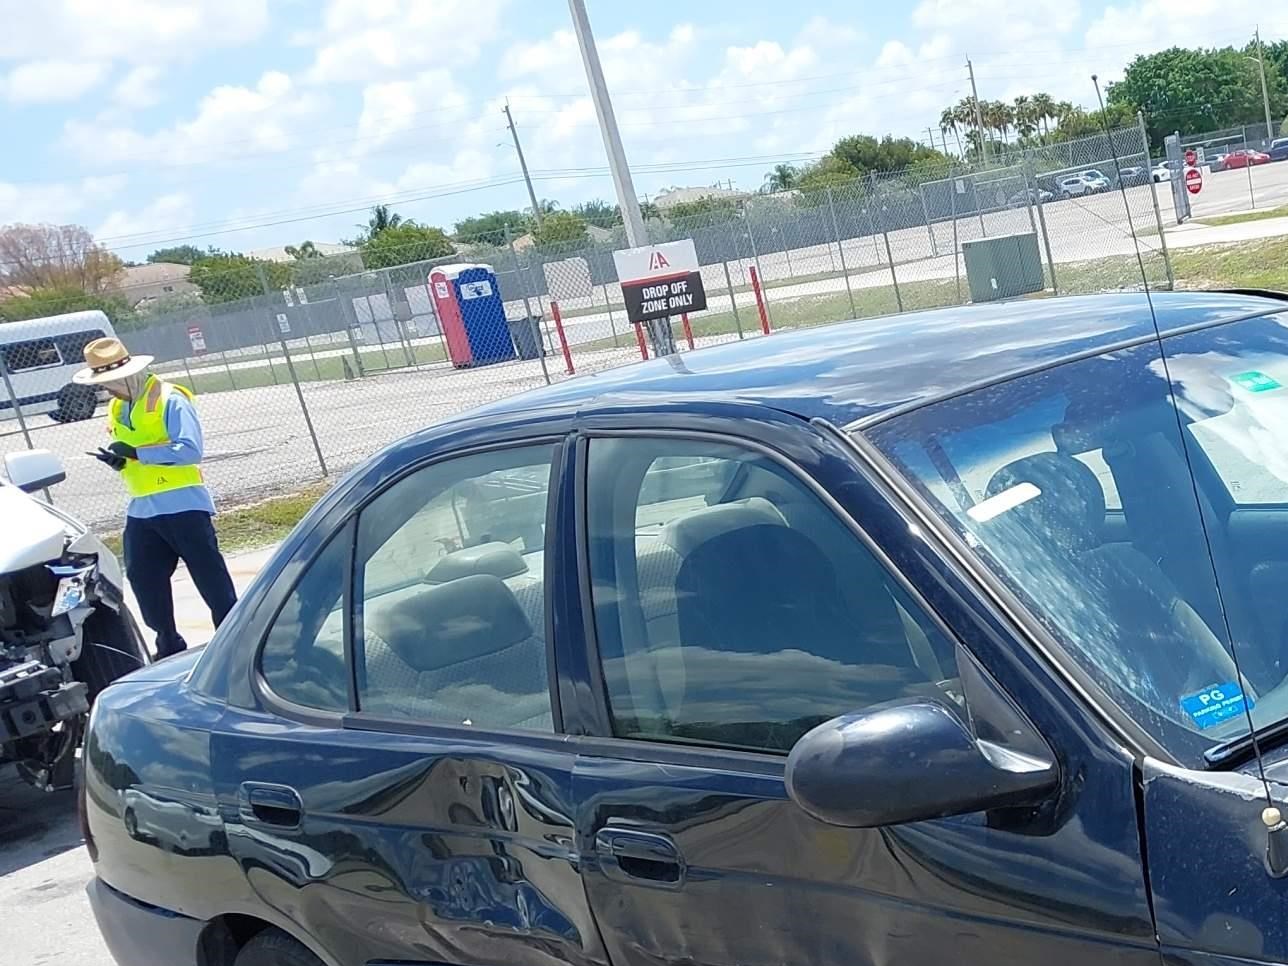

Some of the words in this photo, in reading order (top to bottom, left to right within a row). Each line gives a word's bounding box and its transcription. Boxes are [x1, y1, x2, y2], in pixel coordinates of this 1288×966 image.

[642, 285, 668, 300] DROP
[670, 281, 688, 294] OFF
[641, 297, 668, 314] ZONE
[669, 293, 693, 309] ONLY
[1199, 689, 1225, 706] PG
